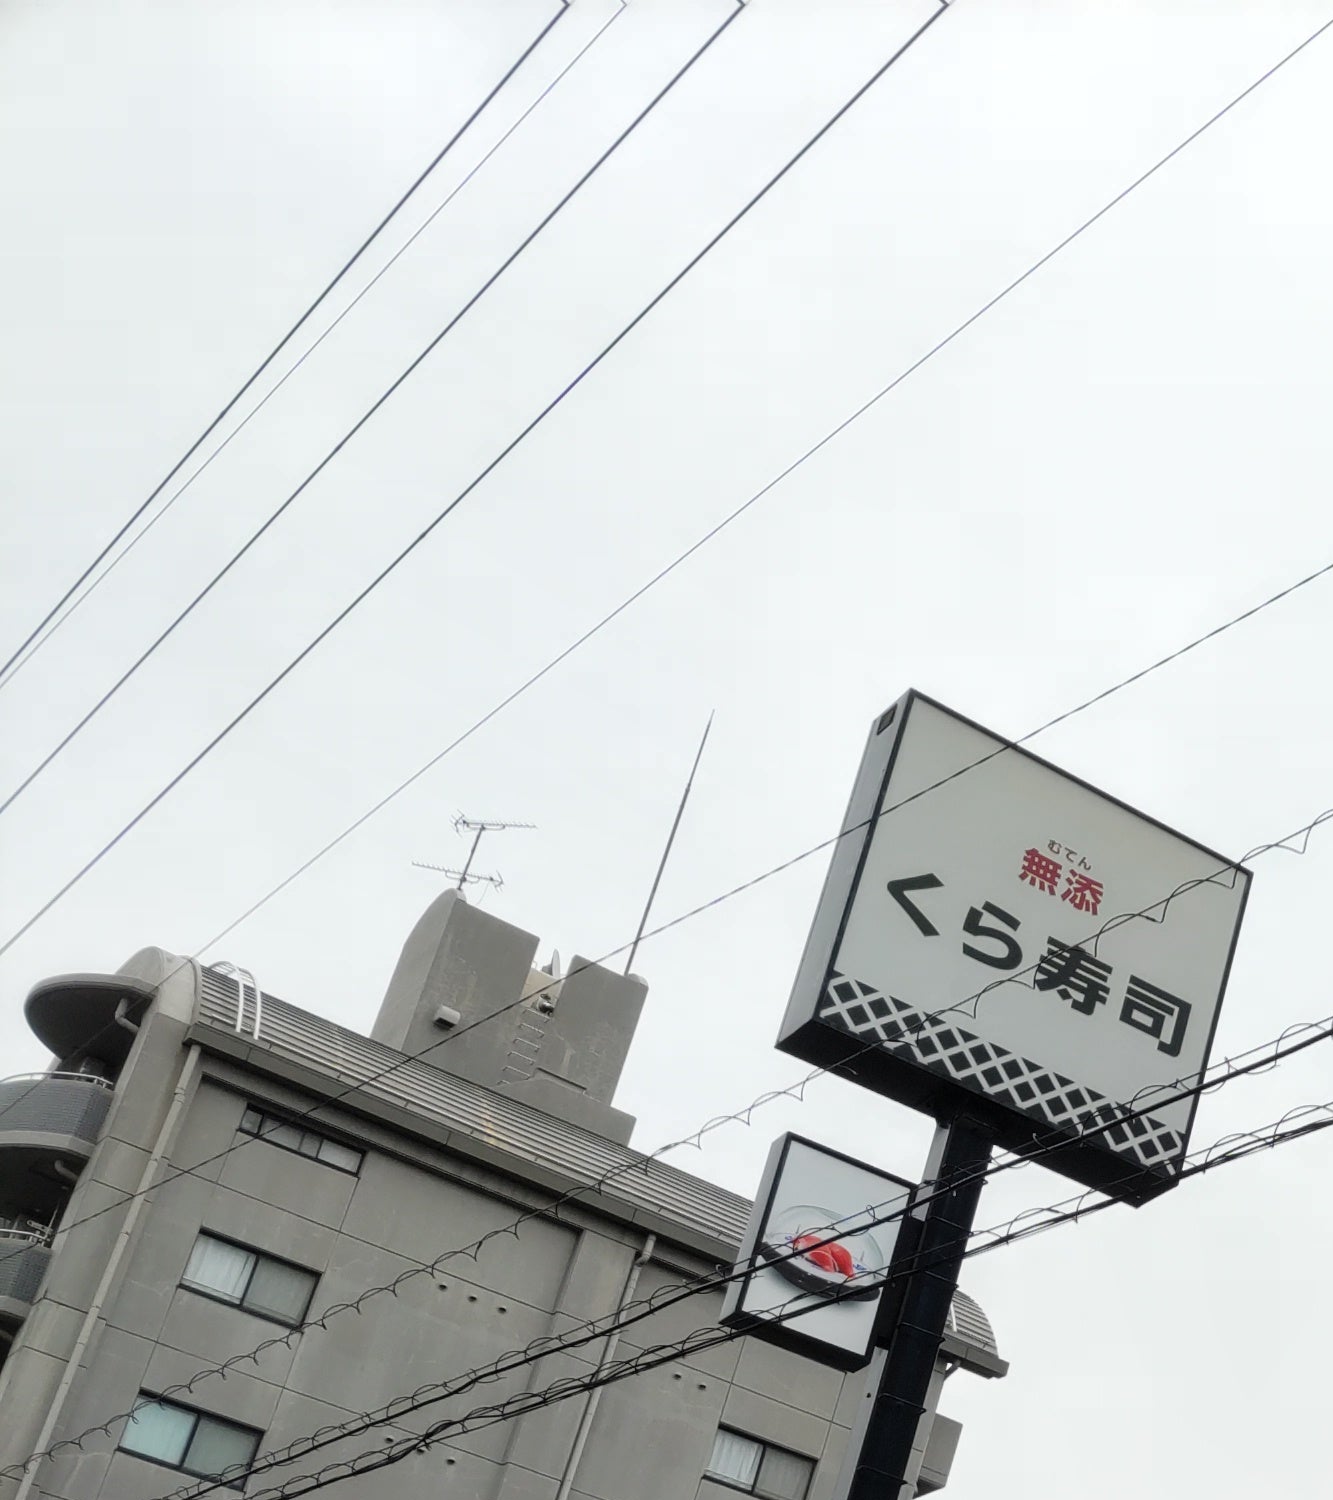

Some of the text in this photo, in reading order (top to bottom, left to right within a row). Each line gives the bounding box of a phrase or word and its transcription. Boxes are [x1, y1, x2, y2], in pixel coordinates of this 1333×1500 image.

[1018, 847, 1105, 916] 無添
[1047, 838, 1093, 872] むてん
[886, 872, 1193, 1058] くら寿司
